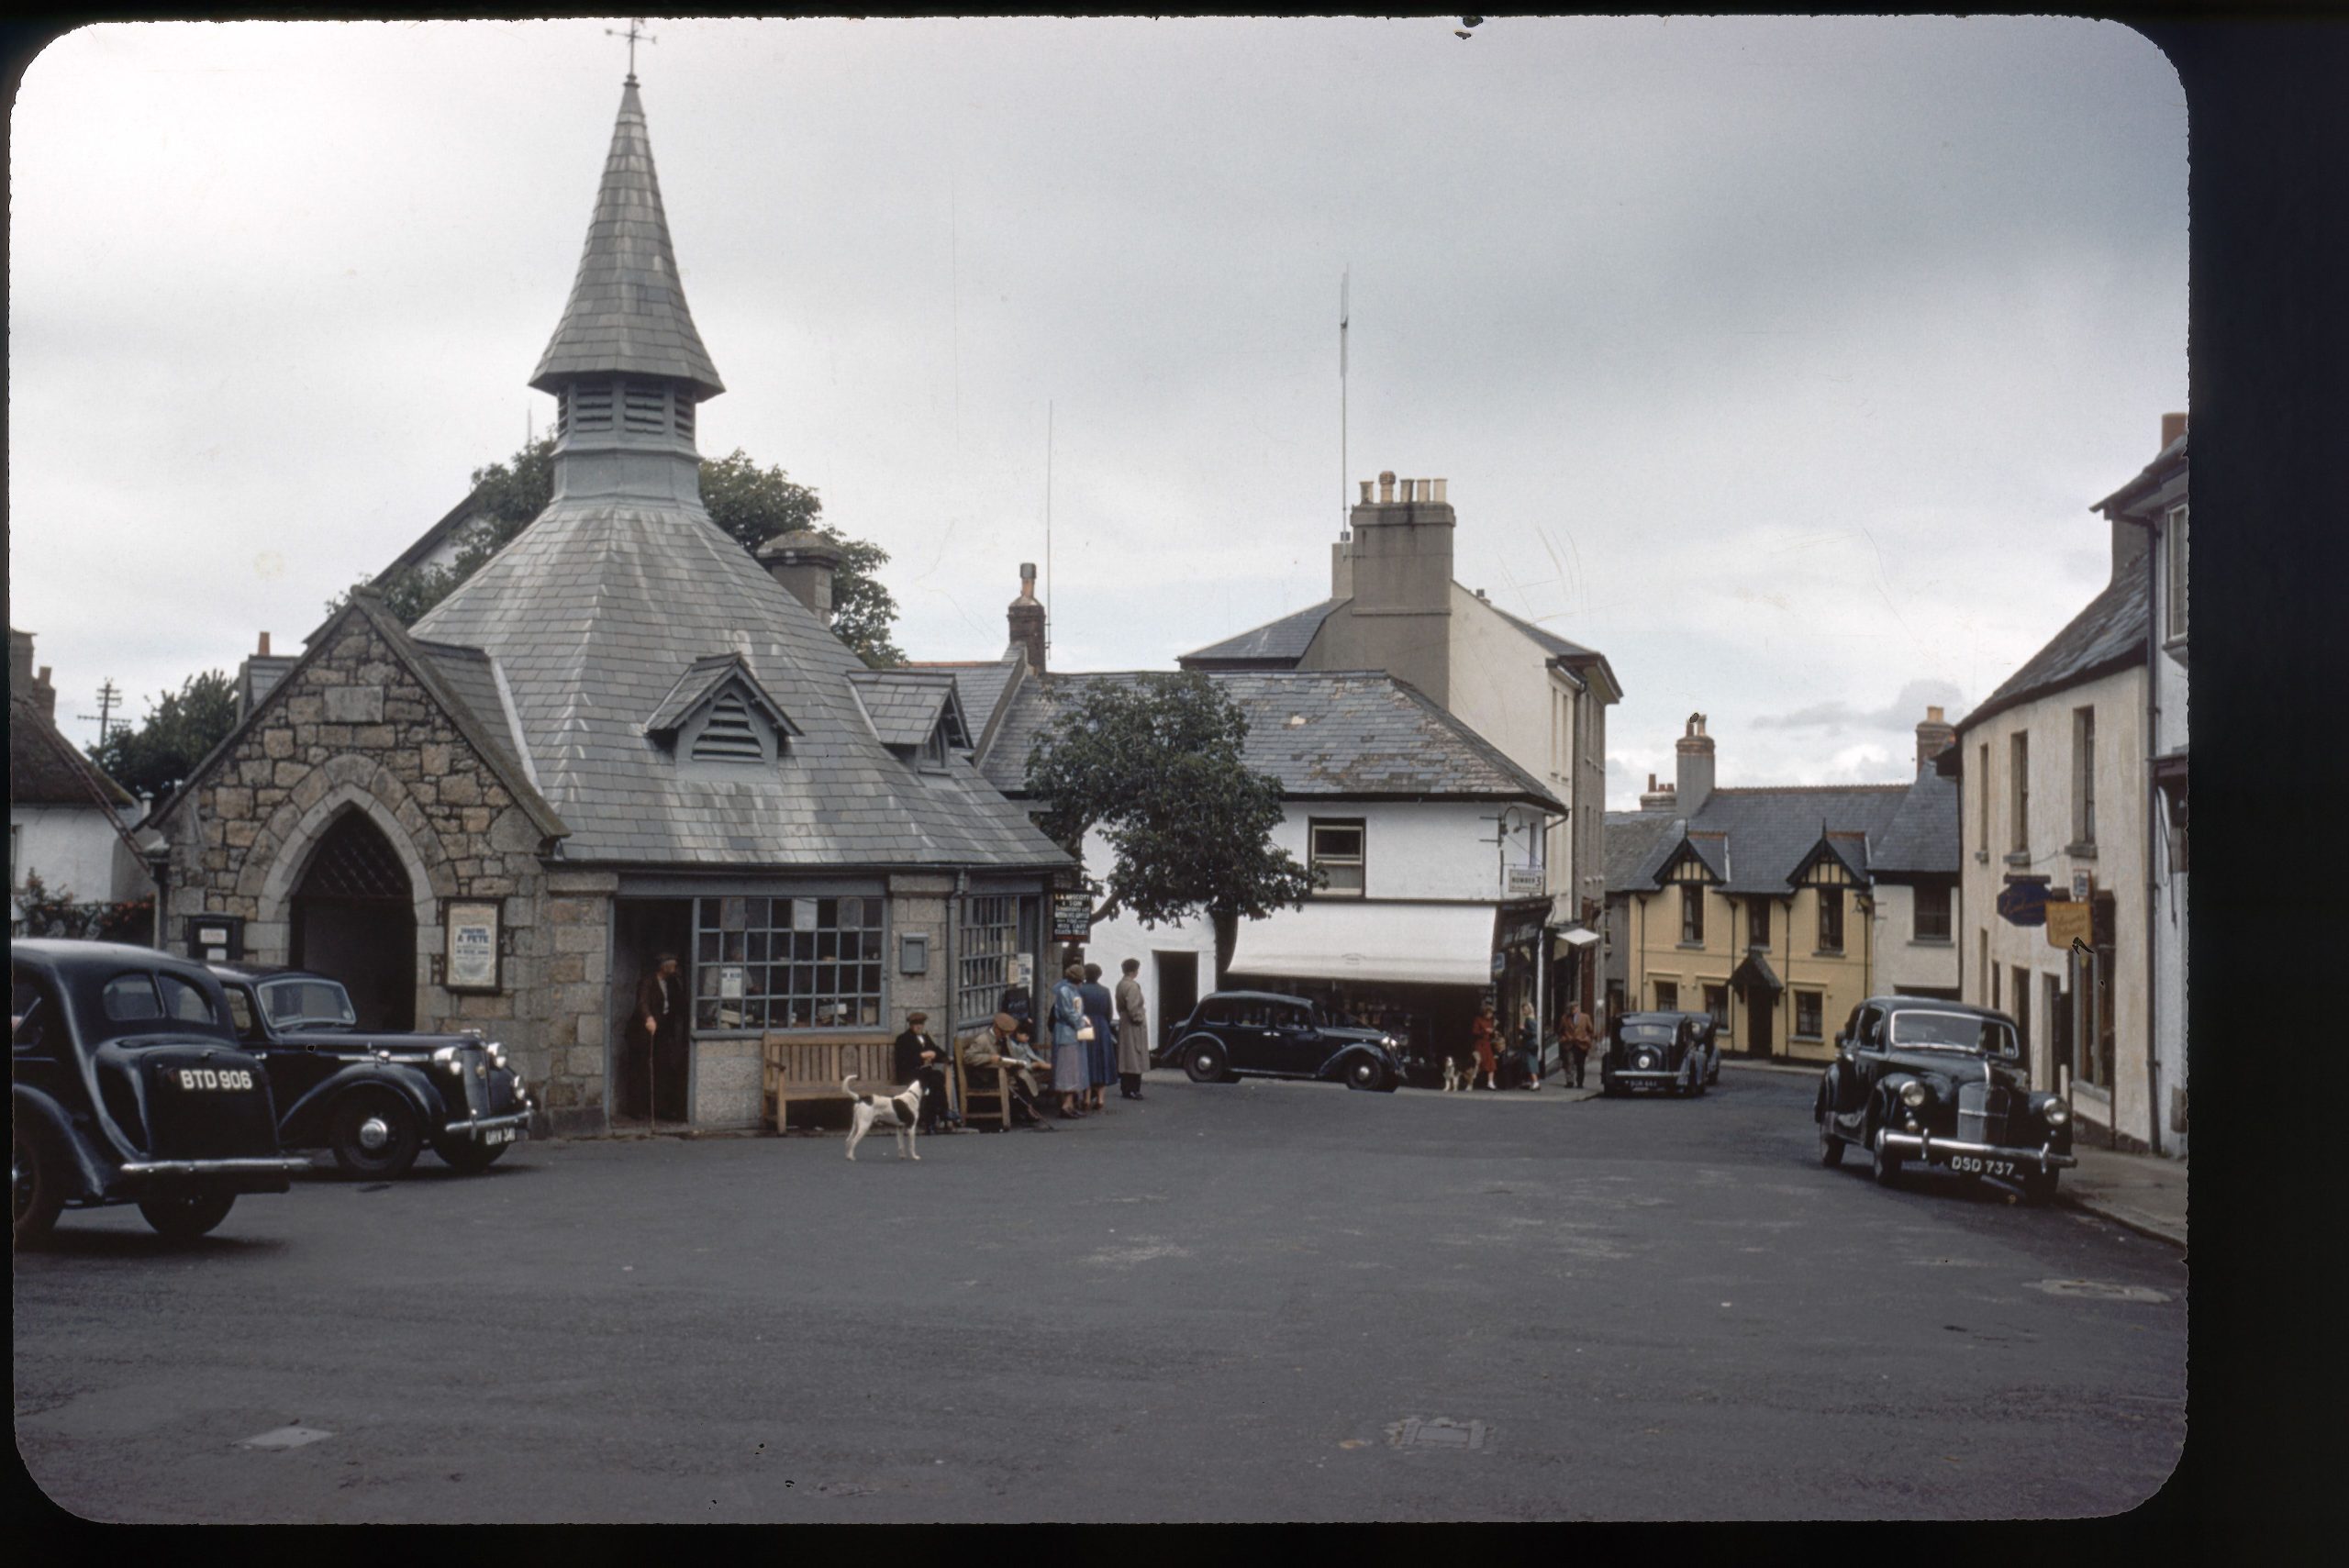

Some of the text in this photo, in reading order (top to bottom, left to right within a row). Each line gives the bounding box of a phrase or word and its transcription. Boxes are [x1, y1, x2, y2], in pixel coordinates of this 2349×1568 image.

[1535, 875, 1542, 887] 3
[180, 1069, 253, 1090] BTD 906
[1952, 1155, 2015, 1176] DSD 737
